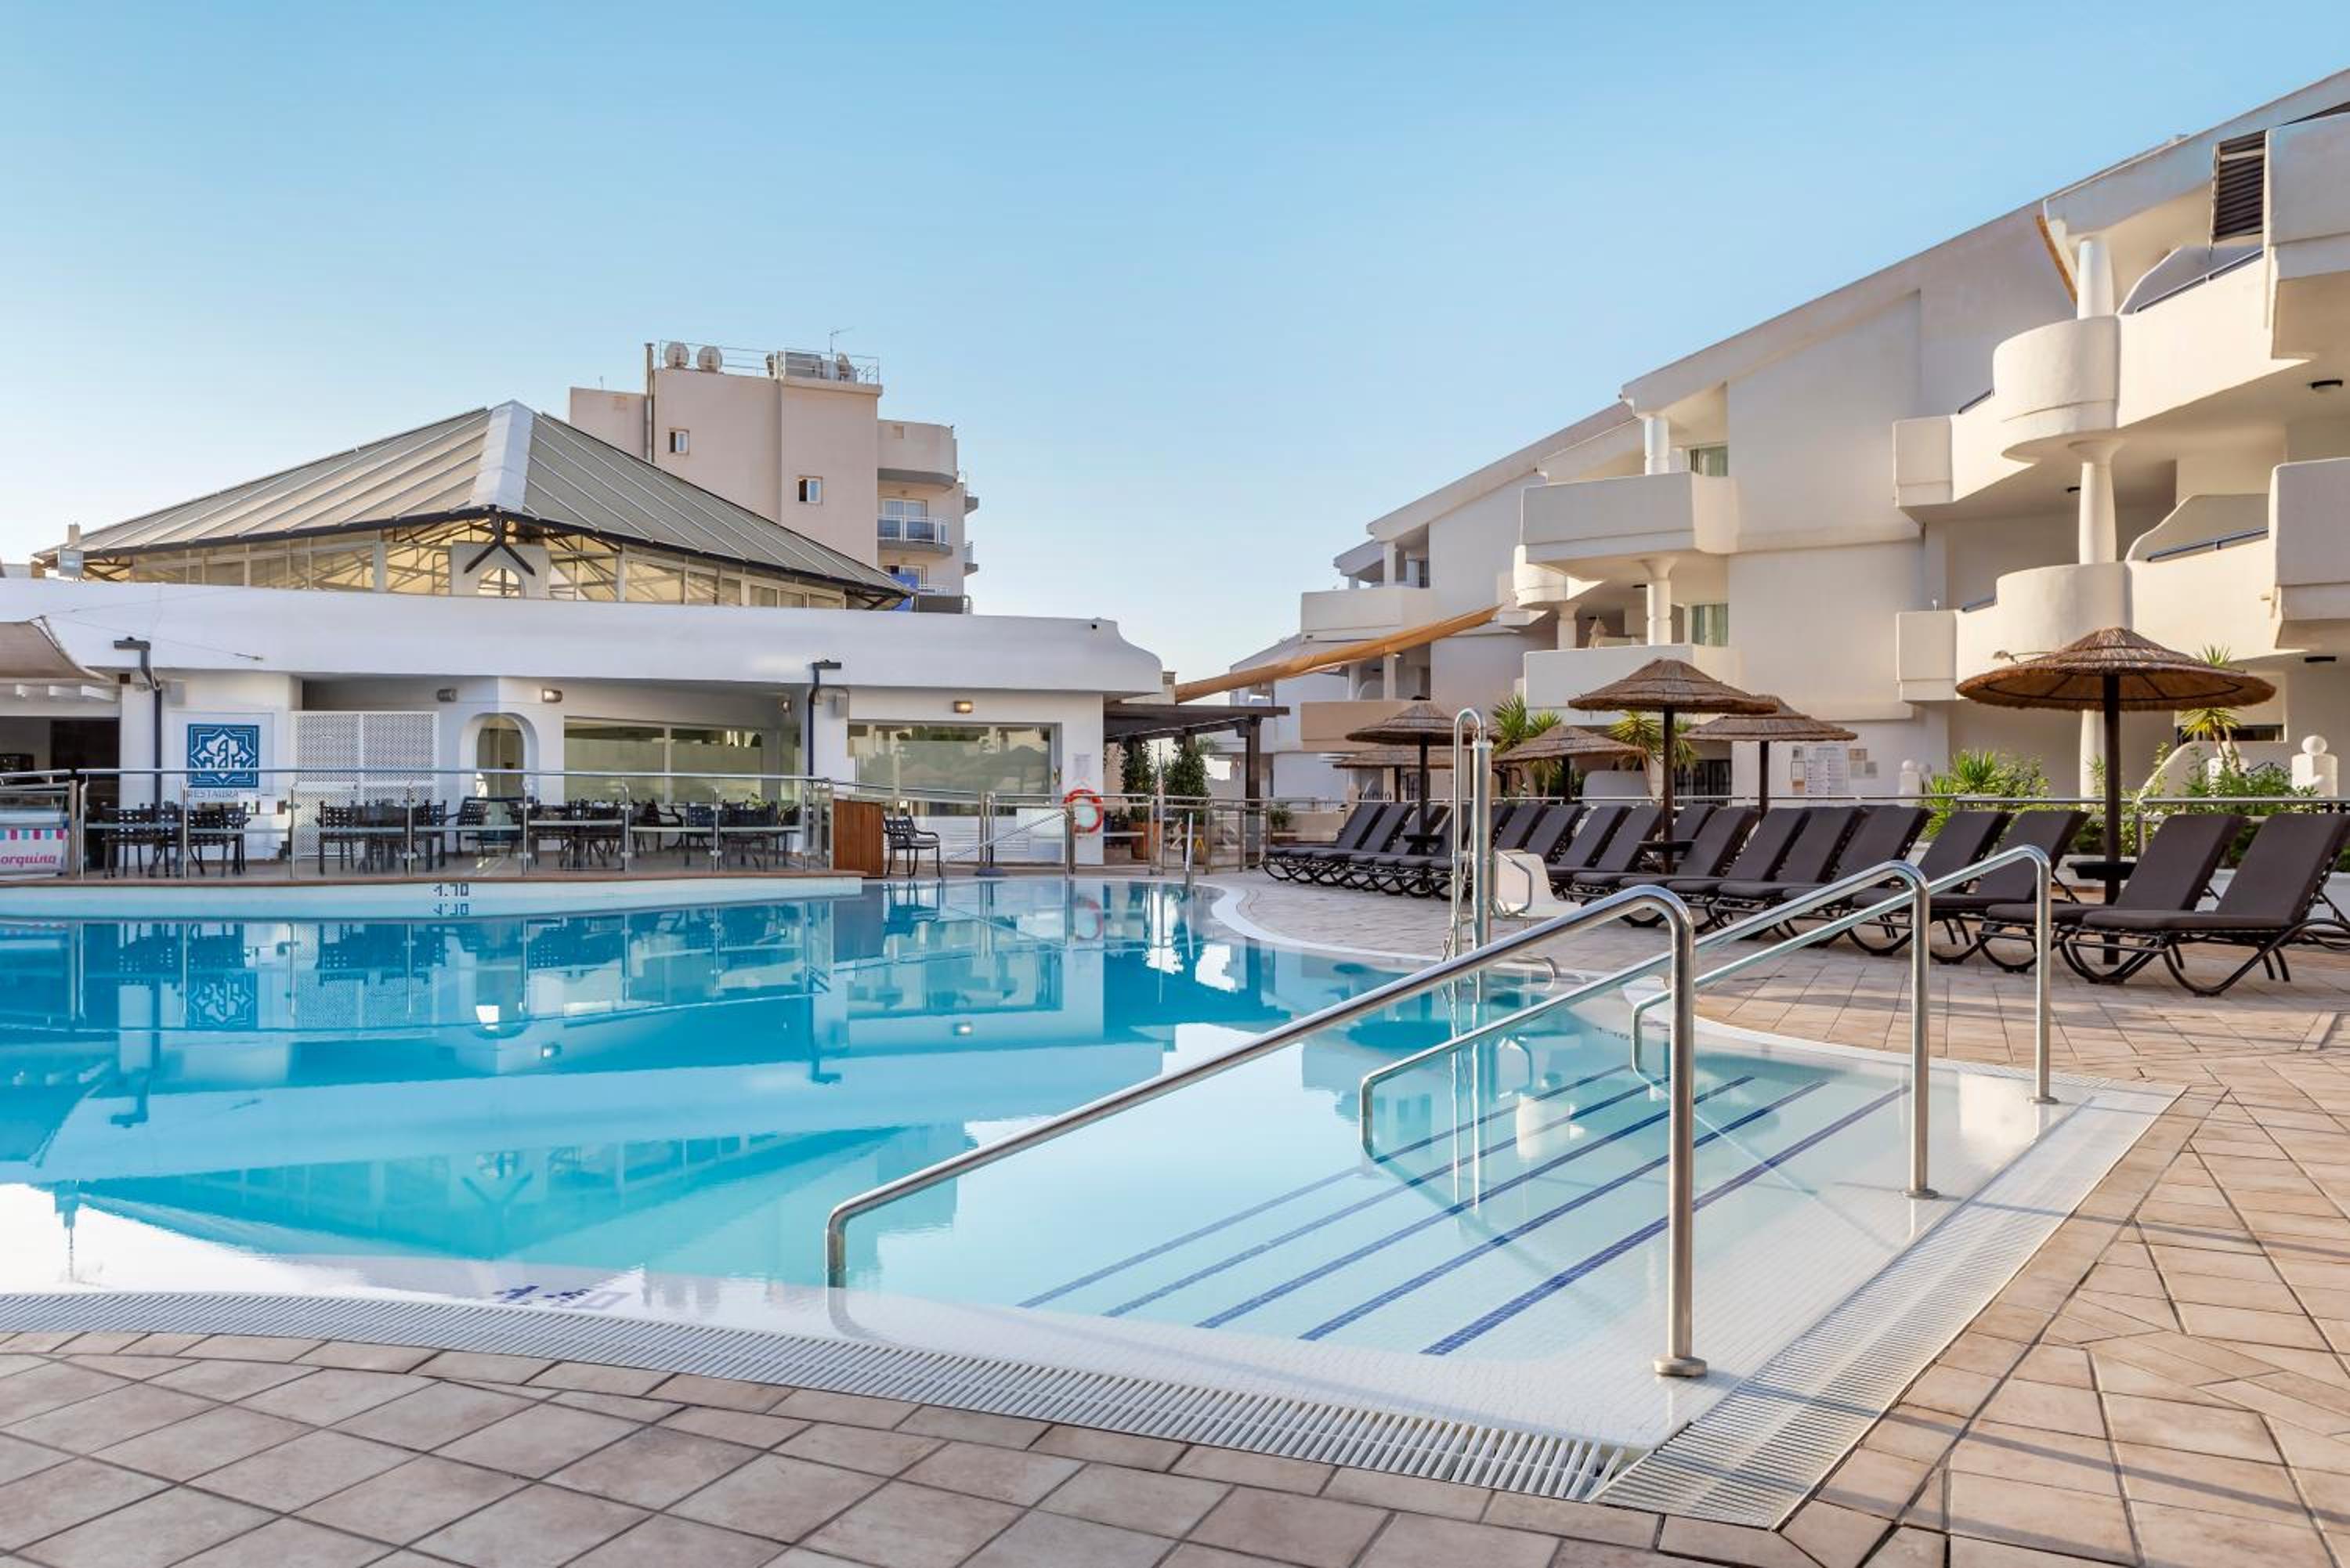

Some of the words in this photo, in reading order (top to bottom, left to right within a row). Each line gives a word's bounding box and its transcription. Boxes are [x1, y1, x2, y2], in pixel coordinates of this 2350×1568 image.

[187, 788, 258, 798] RESTAURA
[0, 853, 56, 868] orquina
[433, 883, 469, 897] 1.70
